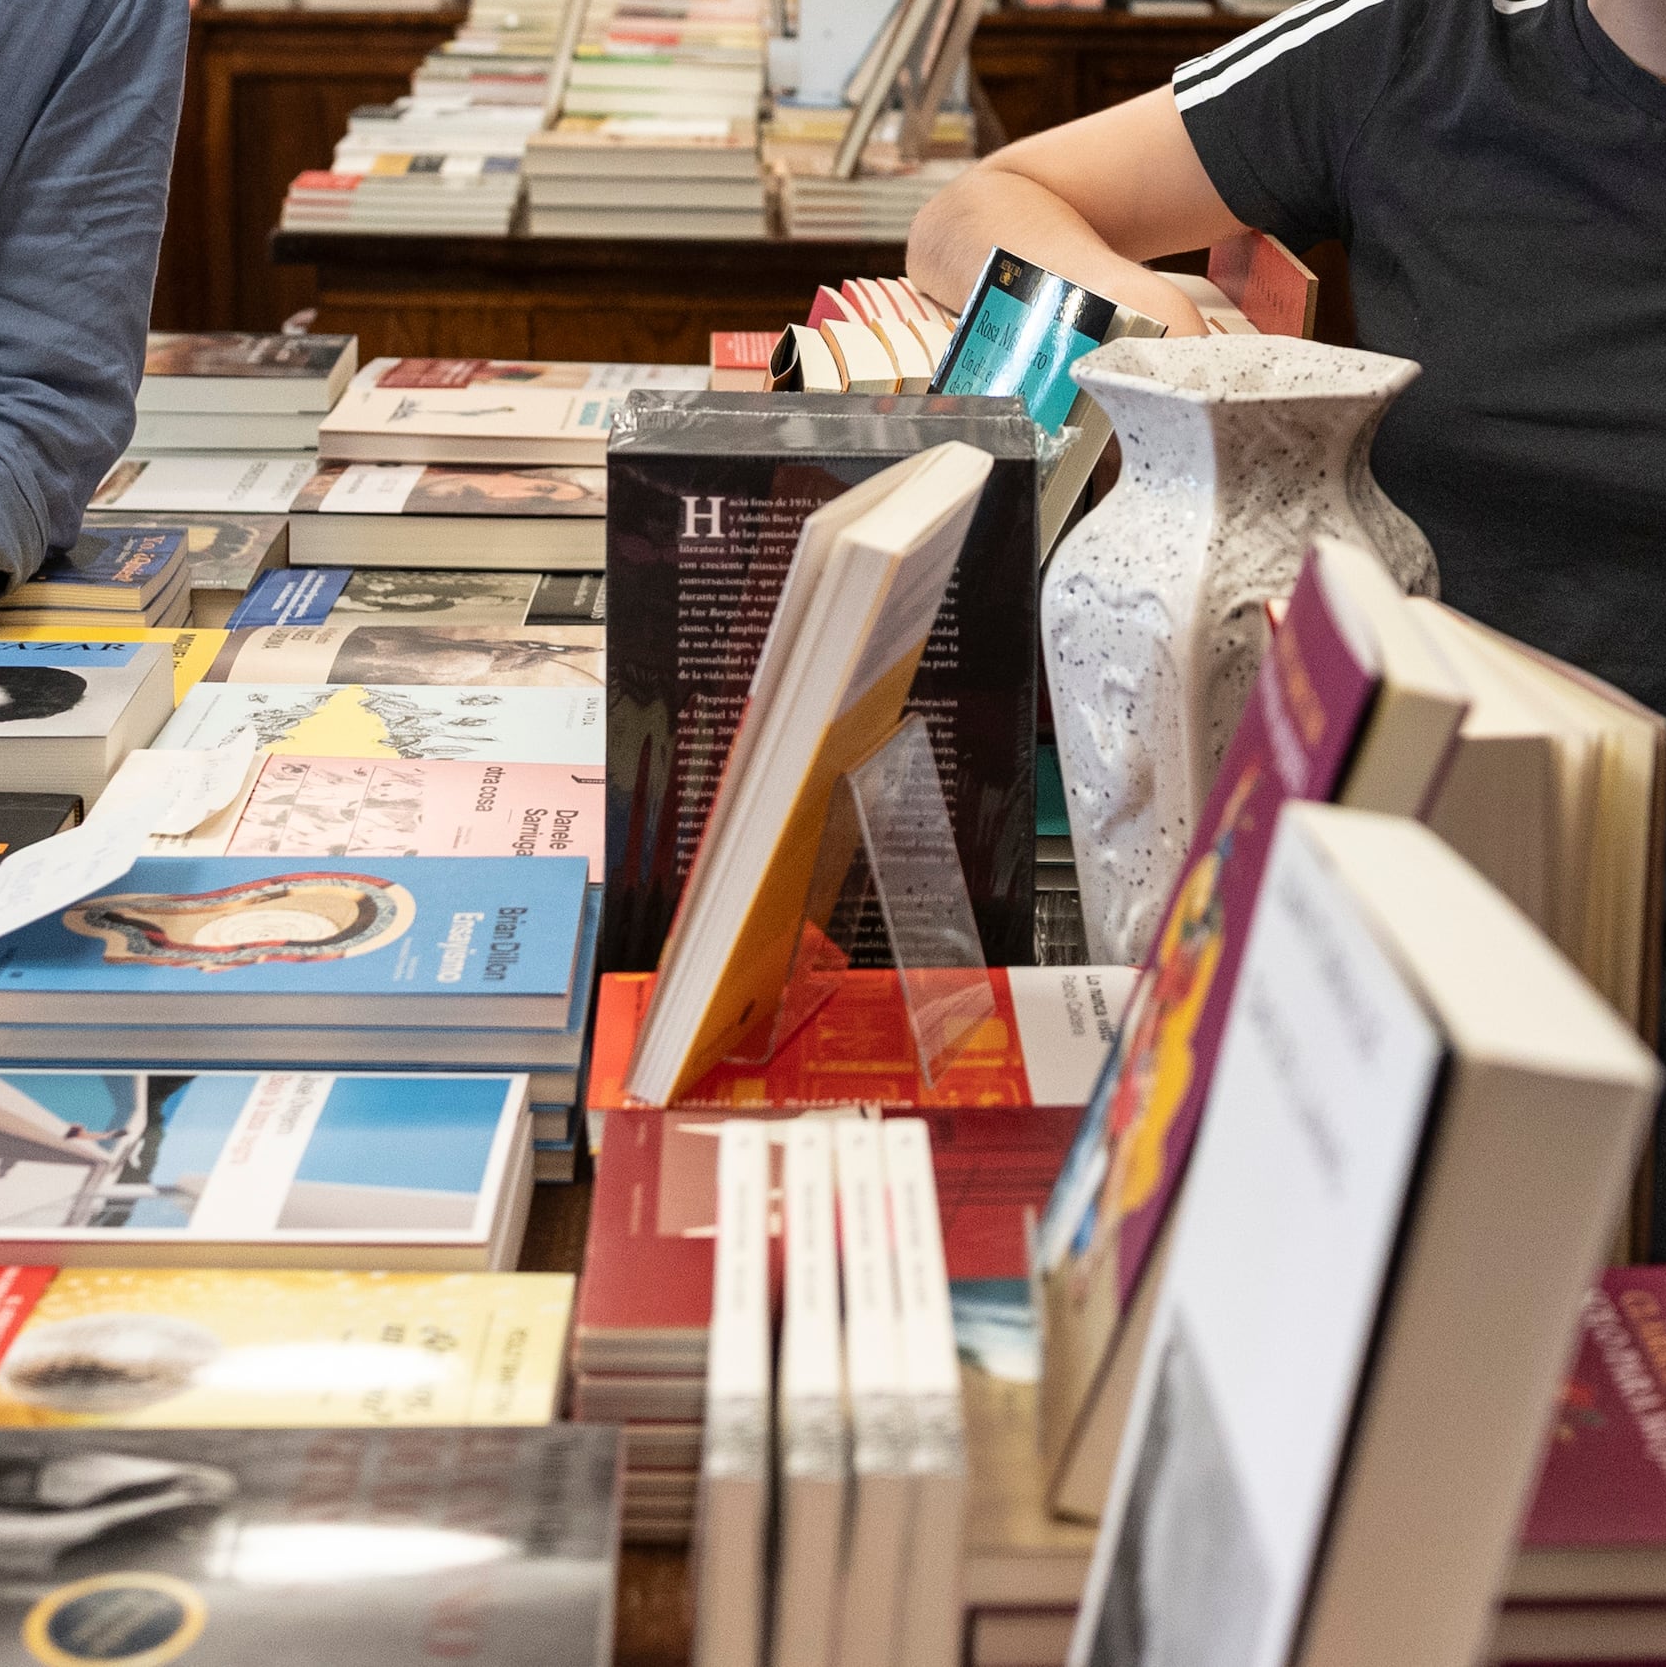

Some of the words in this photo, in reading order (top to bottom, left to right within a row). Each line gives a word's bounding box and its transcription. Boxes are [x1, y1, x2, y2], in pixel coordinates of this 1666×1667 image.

[976, 310, 1000, 344] Rosa
[737, 513, 771, 523] Adolfo
[773, 513, 795, 524] Bioy
[729, 530, 739, 539] de
[742, 530, 756, 539] las
[729, 545, 759, 554] Desde
[709, 608, 744, 619] Borges,
[679, 656, 738, 666] personalidad
[679, 672, 690, 680] de
[692, 672, 702, 680] la
[705, 672, 725, 680] vida
[697, 694, 747, 706] Preparado
[679, 710, 690, 720] de
[693, 710, 728, 720] Daniel
[482, 766, 506, 784] otra
[475, 786, 498, 812] cosa
[549, 809, 579, 850] Danele
[493, 907, 528, 940] Brian
[436, 911, 485, 984] Ensayismo
[483, 942, 521, 981] Dillon
[1088, 988, 1109, 1017] nunca
